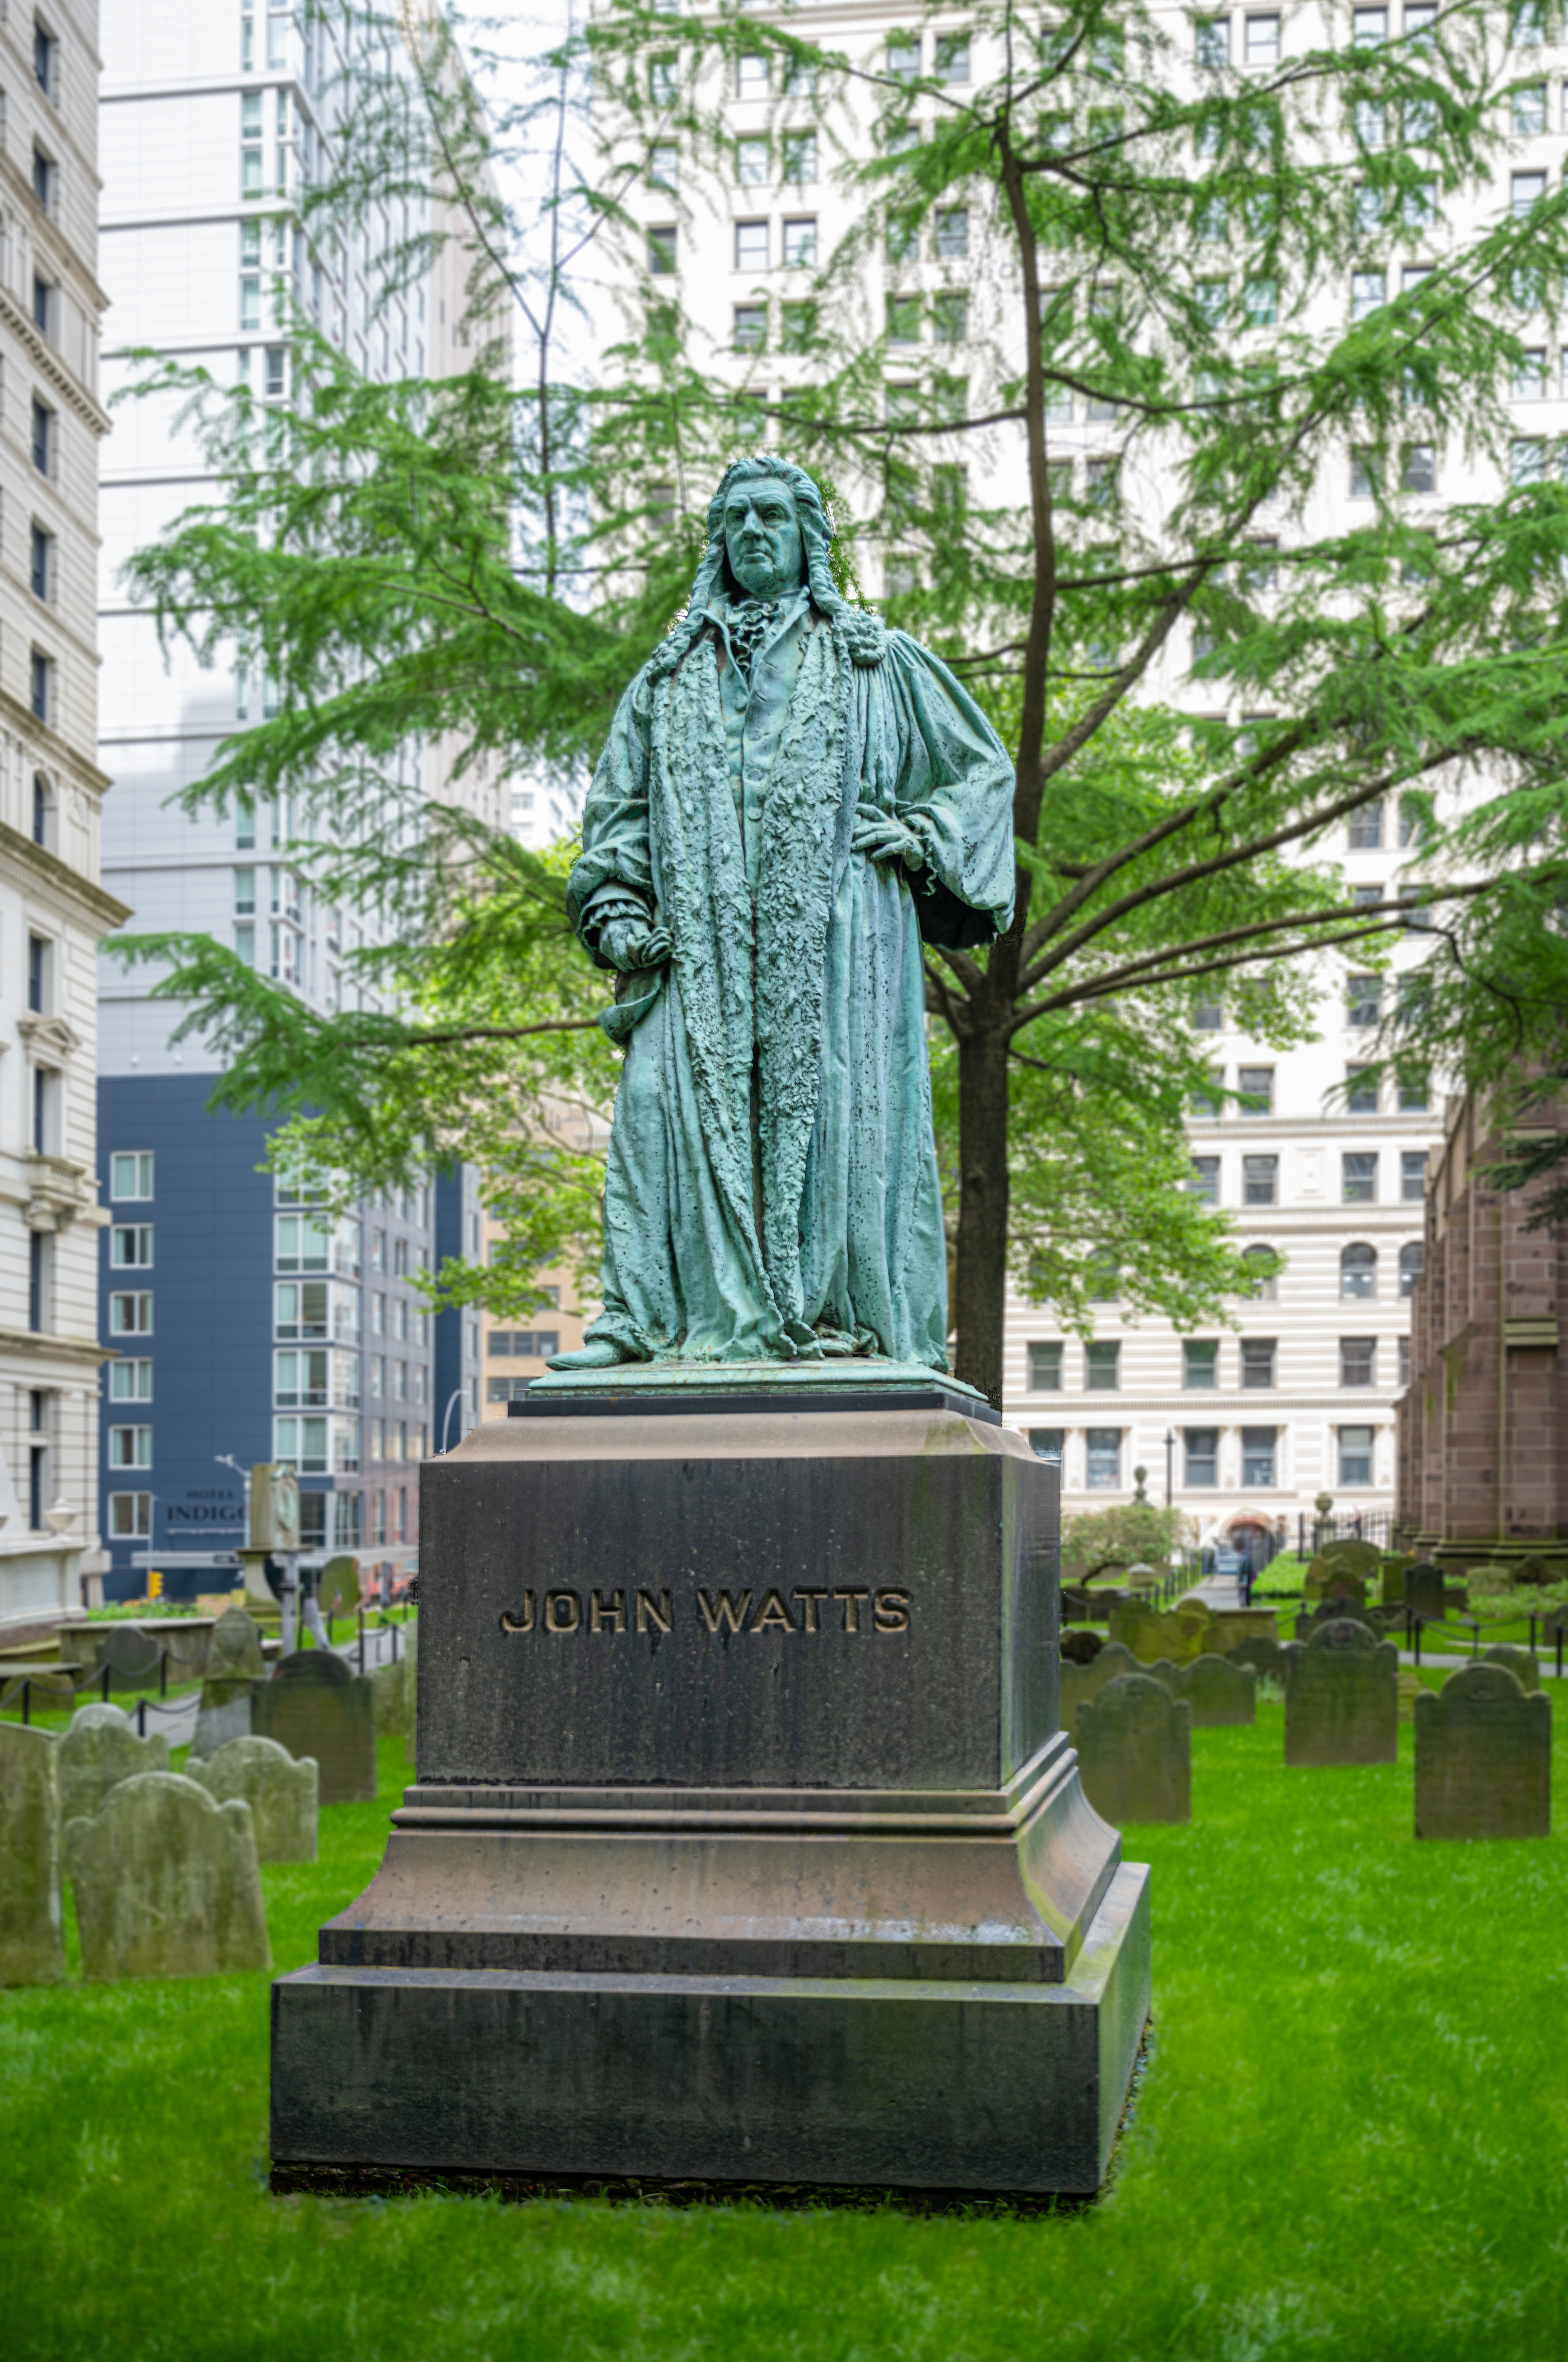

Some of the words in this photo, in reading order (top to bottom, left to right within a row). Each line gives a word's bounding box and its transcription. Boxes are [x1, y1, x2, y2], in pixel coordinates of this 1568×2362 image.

[187, 1490, 234, 1500] HOTEL
[501, 1588, 672, 1632] JOHN
[696, 1586, 912, 1632] WATTS
